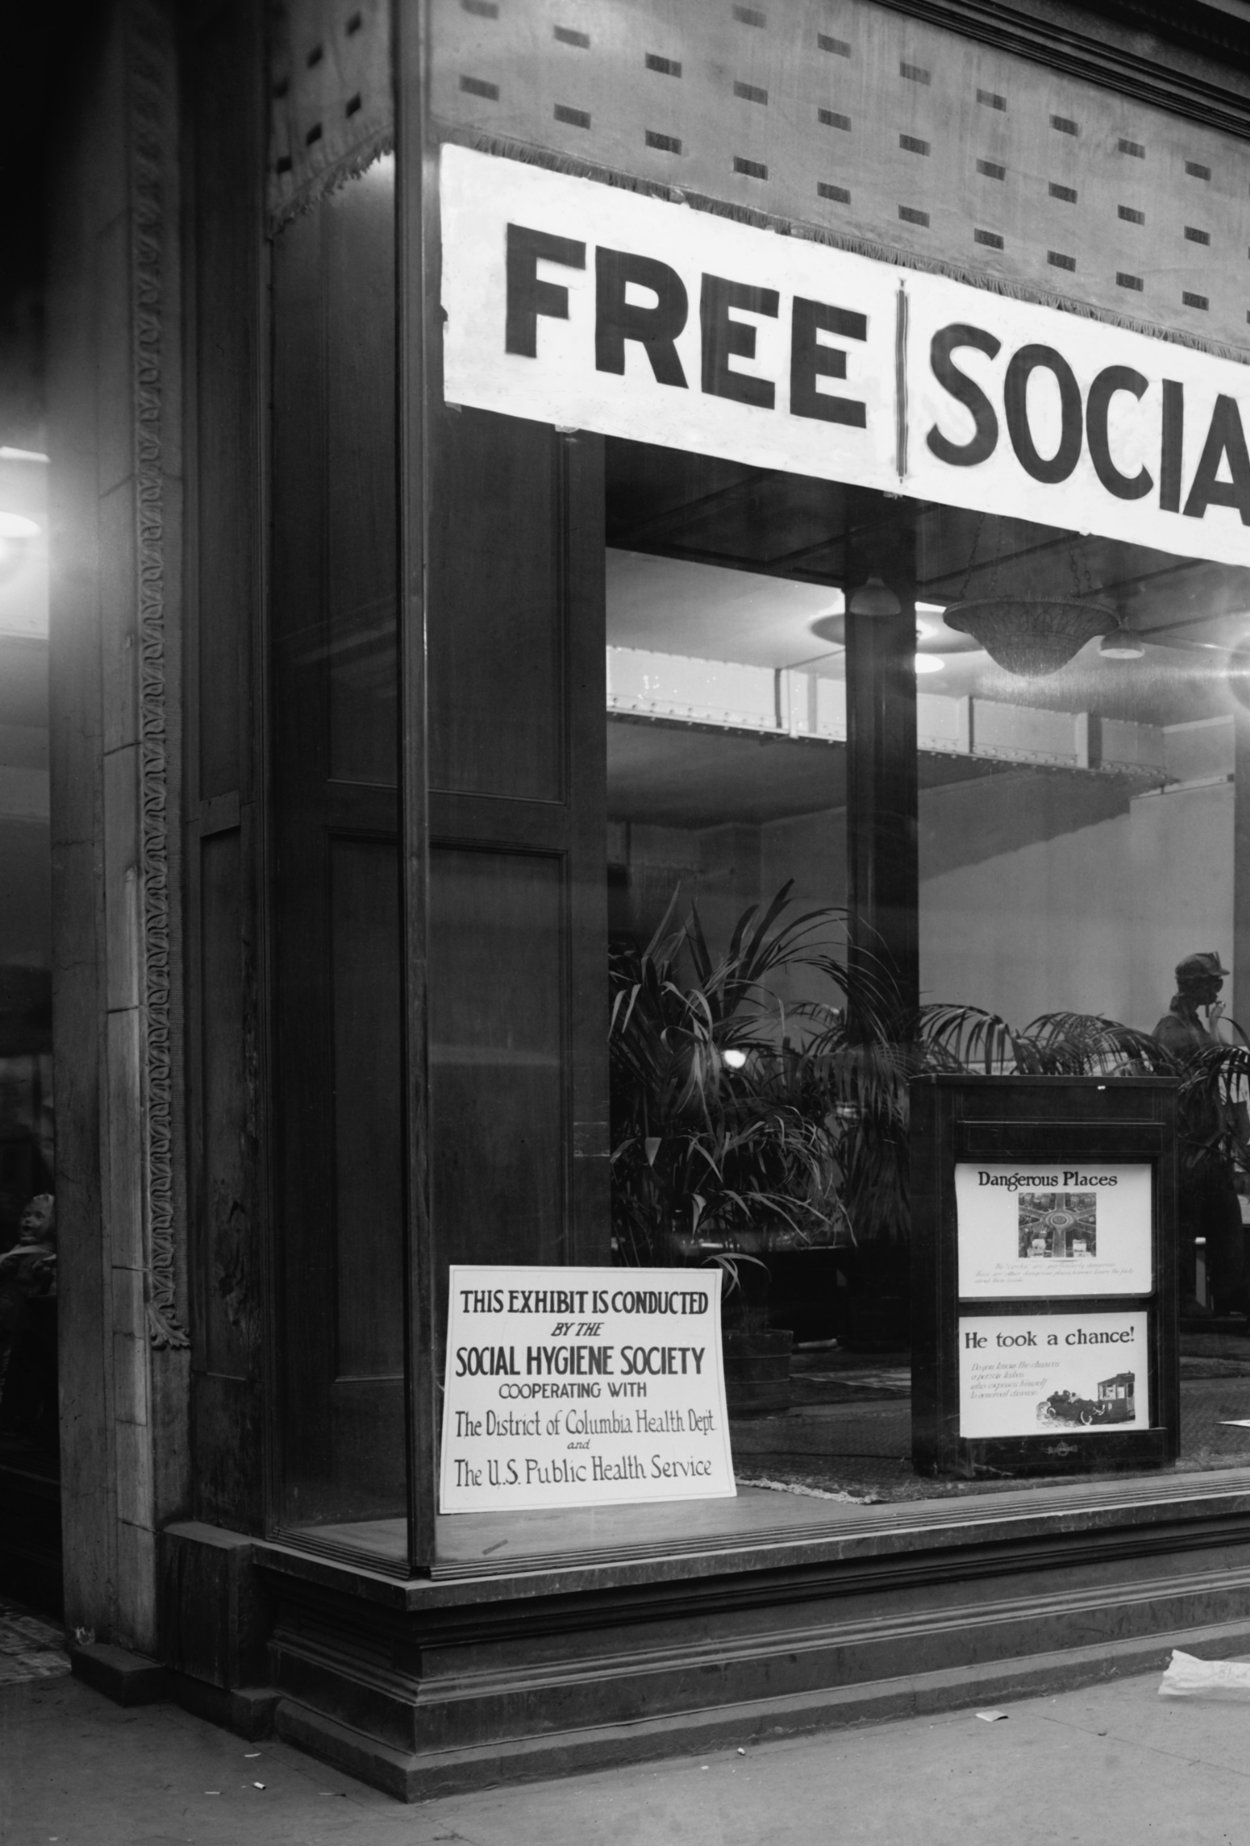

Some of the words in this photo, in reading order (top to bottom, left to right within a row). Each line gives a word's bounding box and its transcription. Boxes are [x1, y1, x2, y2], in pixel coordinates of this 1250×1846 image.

[505, 222, 867, 429] FREE
[977, 1171, 1059, 1192] Dangerous
[1062, 1171, 1118, 1187] Places
[460, 1290, 504, 1313] THIS
[508, 1290, 589, 1313] EXHIBIT
[592, 1290, 609, 1314] IS
[611, 1291, 709, 1315] CONDUCTED
[551, 1322, 575, 1337] BY
[575, 1322, 604, 1337] THE
[965, 1332, 988, 1349] He
[996, 1331, 1037, 1347] took
[1047, 1334, 1058, 1345] a
[1065, 1326, 1135, 1345] chance!
[456, 1346, 521, 1377] SOCIAL
[526, 1346, 614, 1375] HYGIENE
[620, 1346, 705, 1375] SOCIETY
[499, 1382, 602, 1399] COOPERATING
[607, 1382, 647, 1398] WITH
[455, 1411, 482, 1437] The
[486, 1410, 541, 1436] District
[546, 1410, 563, 1436] of
[566, 1409, 632, 1435] Columbia
[635, 1409, 685, 1433] Health
[567, 1440, 590, 1450] and
[454, 1459, 482, 1487] The
[487, 1458, 521, 1486] U.S.
[525, 1458, 587, 1484] Public
[591, 1455, 647, 1481] Health
[651, 1454, 712, 1479] Service
